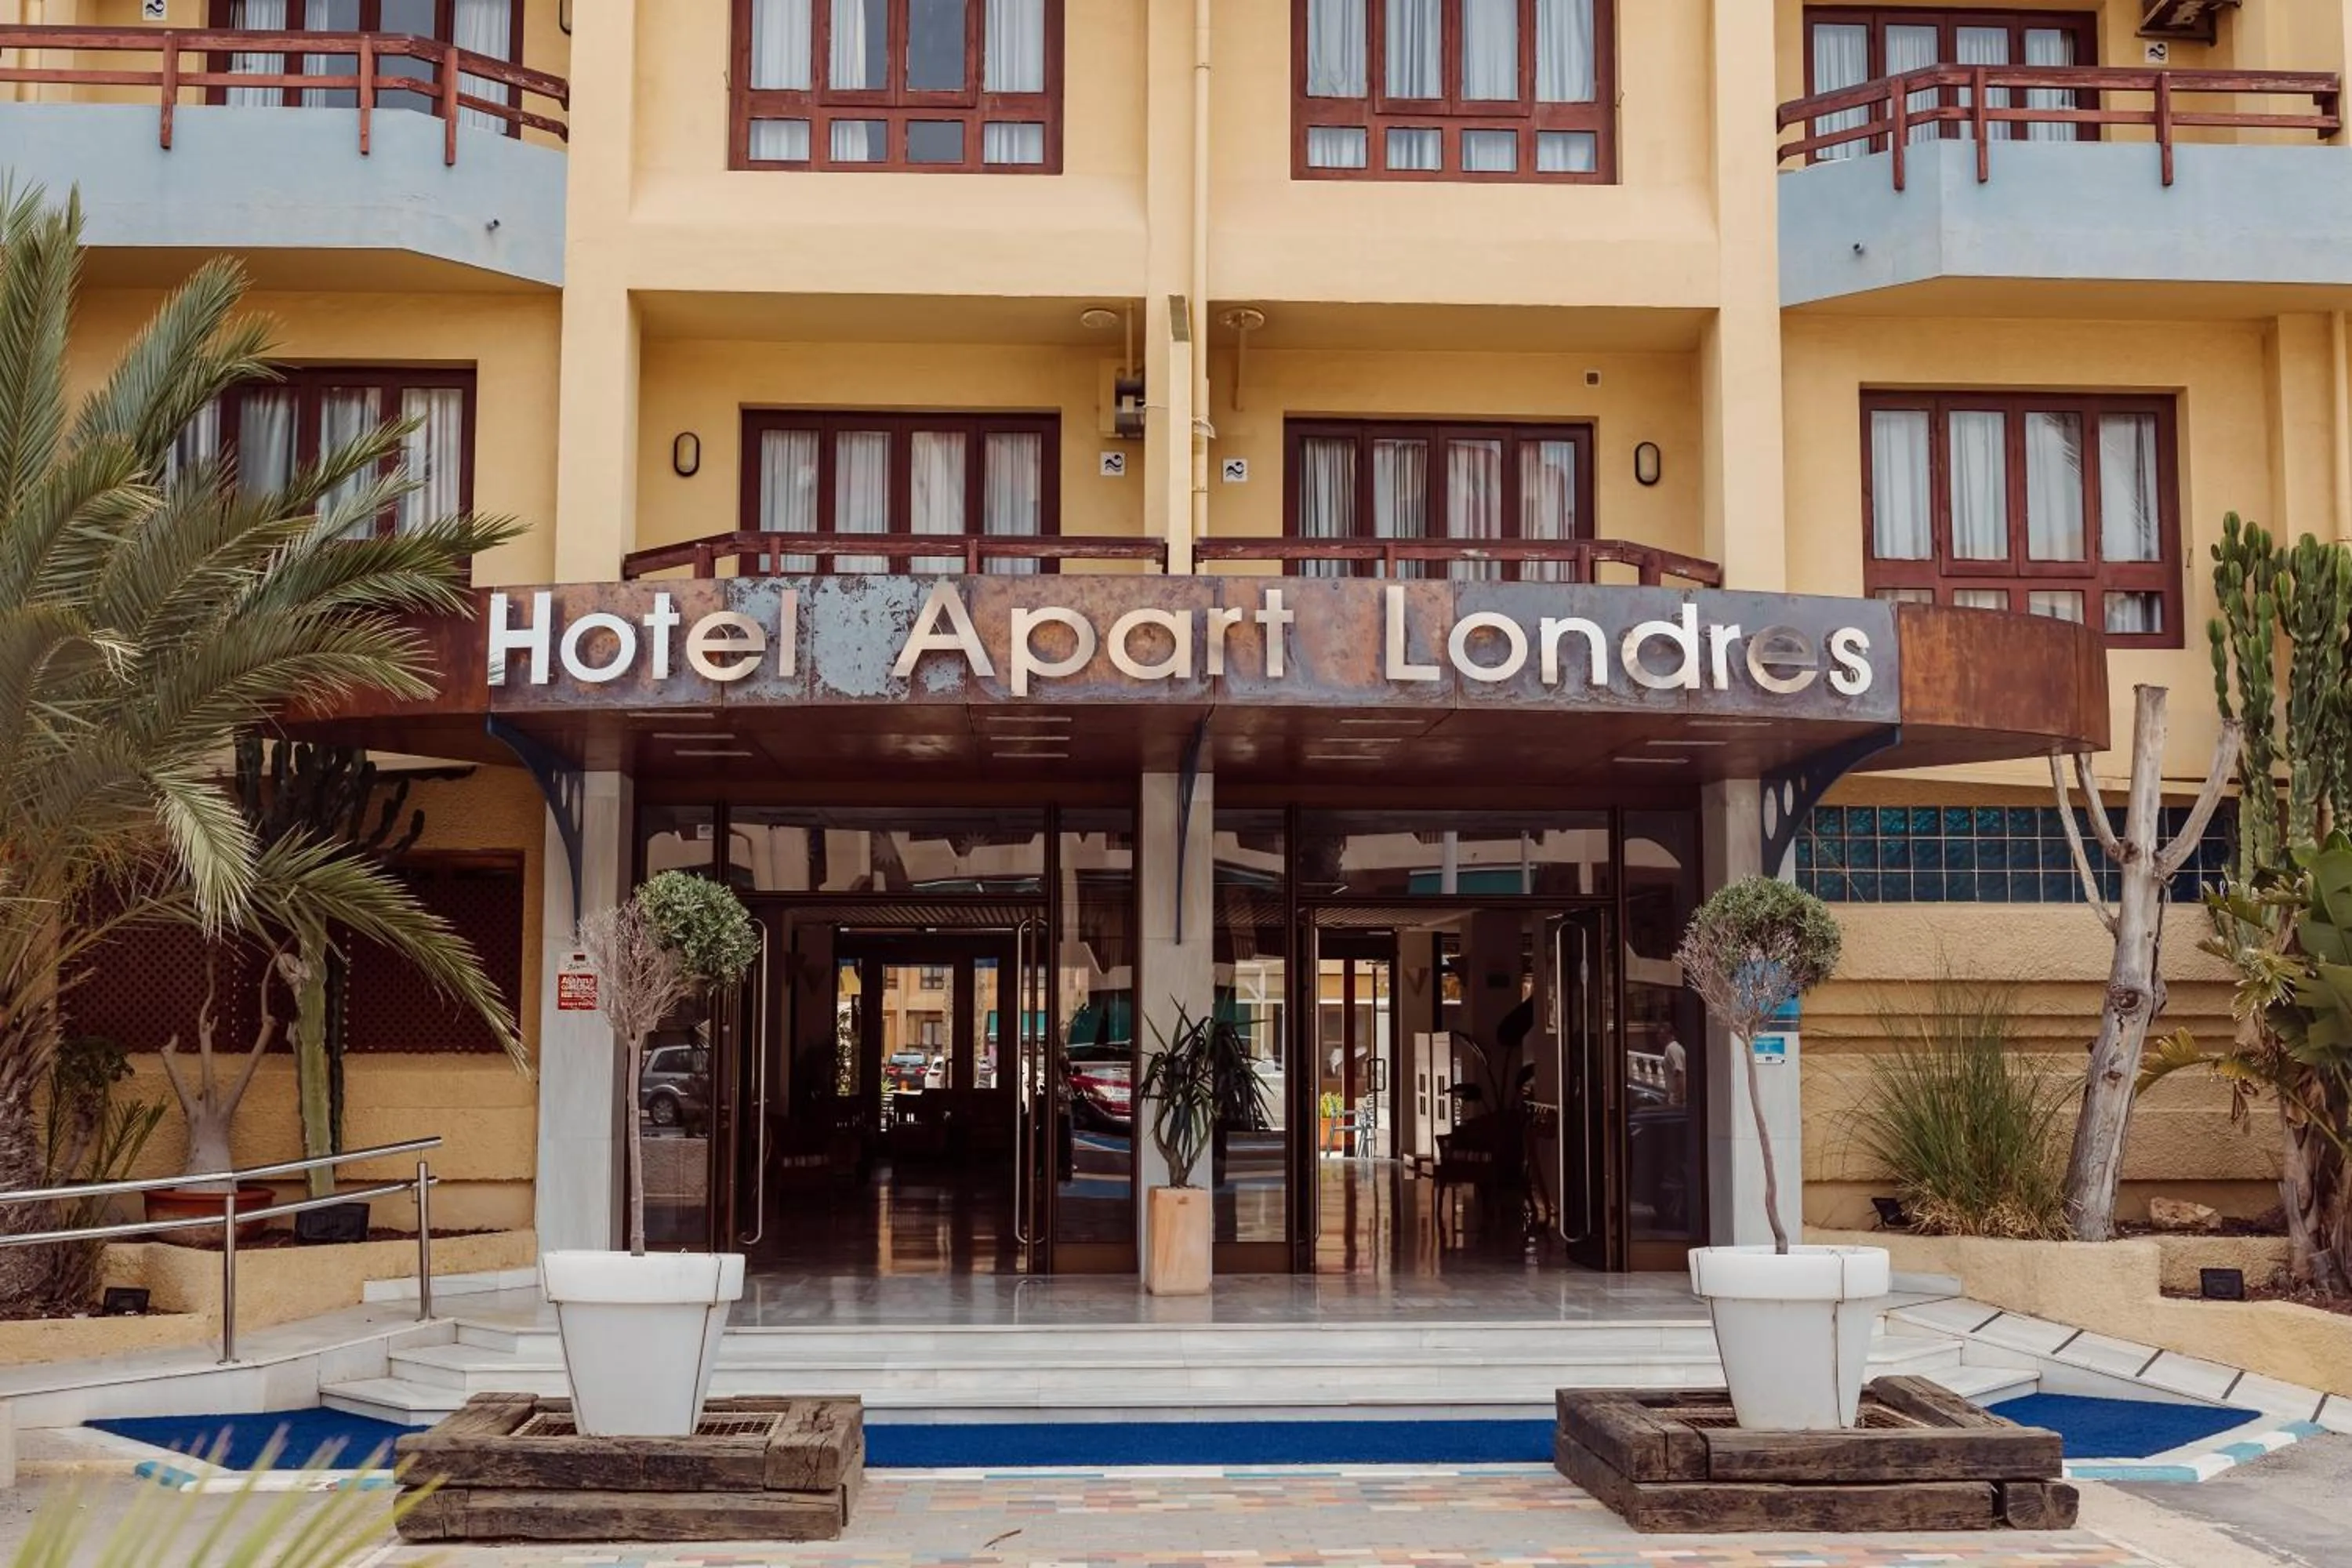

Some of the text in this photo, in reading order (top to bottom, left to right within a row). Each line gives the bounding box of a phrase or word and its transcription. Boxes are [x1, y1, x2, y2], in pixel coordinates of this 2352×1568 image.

[488, 581, 1874, 697] Hotel Apart Londres
